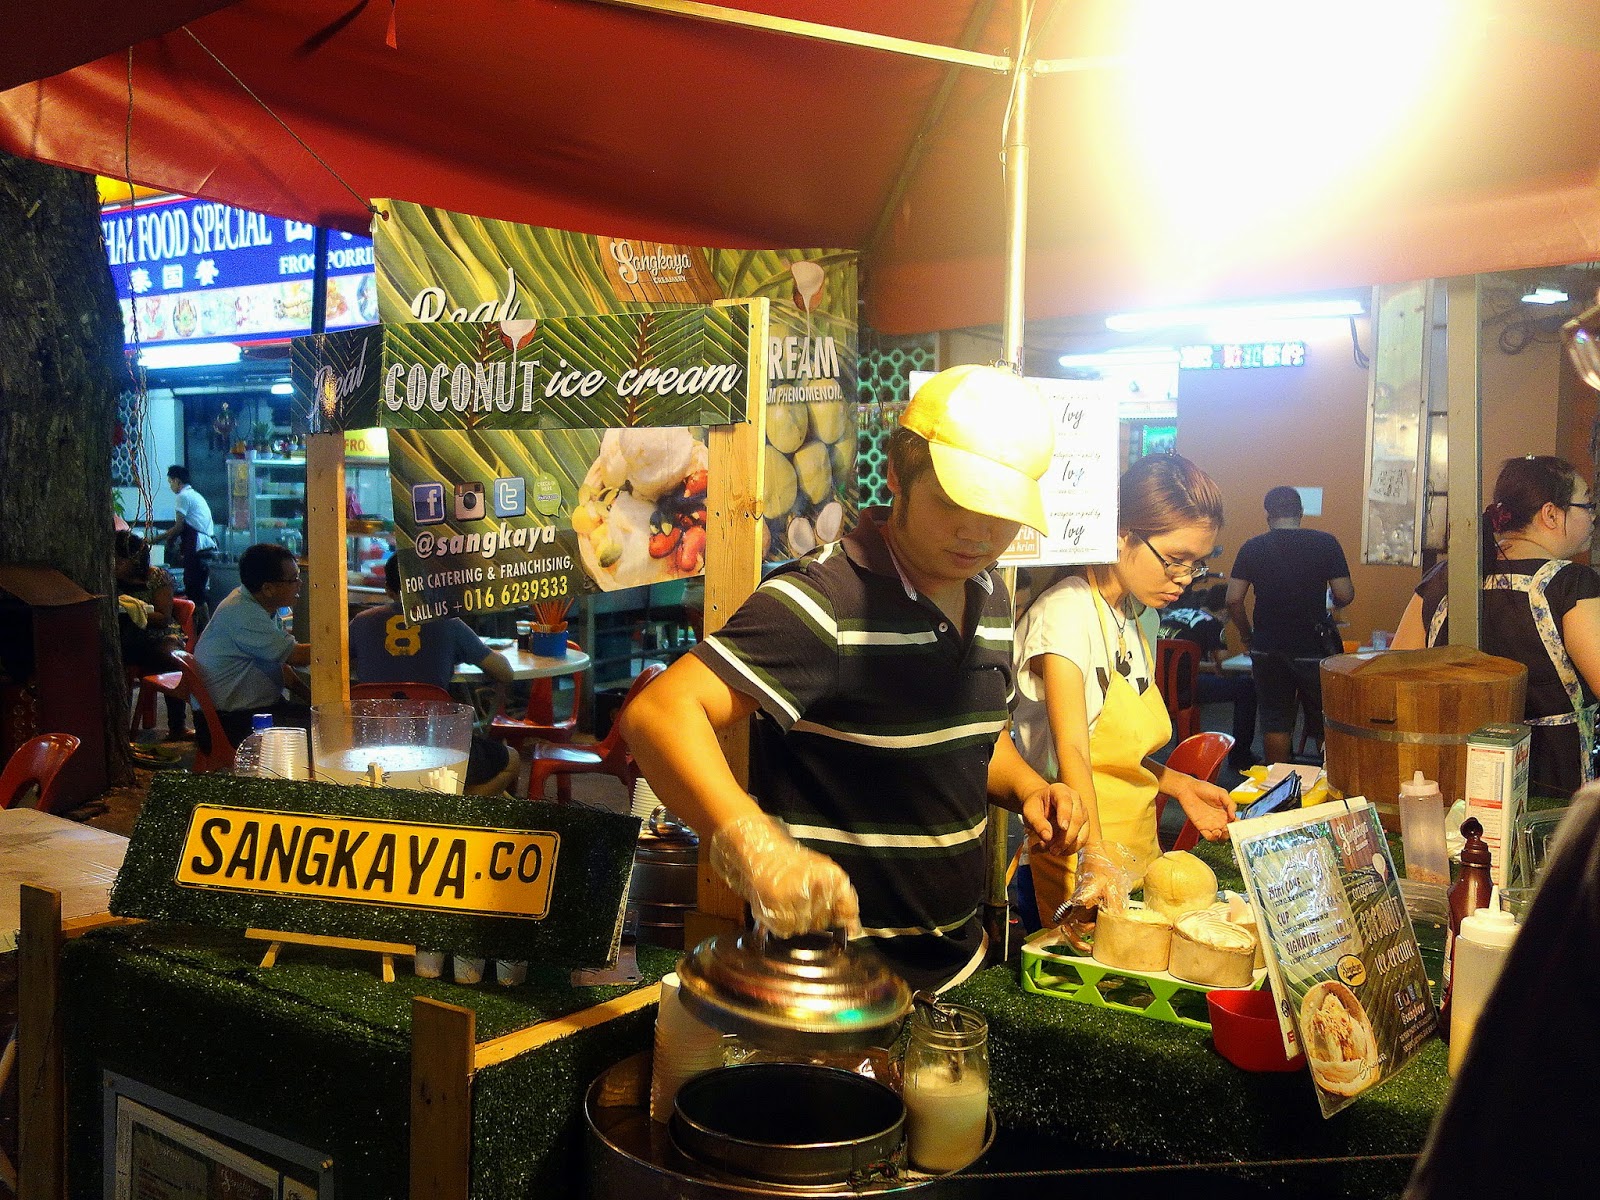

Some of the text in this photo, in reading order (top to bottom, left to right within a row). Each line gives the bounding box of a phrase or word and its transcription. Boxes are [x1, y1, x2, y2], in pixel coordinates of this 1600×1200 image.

[137, 207, 190, 262] FOOD
[192, 202, 273, 255] SPECIAL
[327, 246, 375, 270] PORRI
[609, 241, 692, 285] Sangkaya
[768, 336, 840, 380] REAM
[385, 359, 743, 412] COCONUT ice cream
[416, 521, 556, 559] @sangkaya
[405, 555, 575, 594] FOR CATERING & FRANCHISING,
[409, 603, 433, 622] CALL
[435, 600, 449, 617] US
[501, 575, 568, 605] 6239333
[385, 614, 421, 657] 8
[1276, 911, 1290, 927] CUP
[1285, 931, 1321, 956] SIGNATURE
